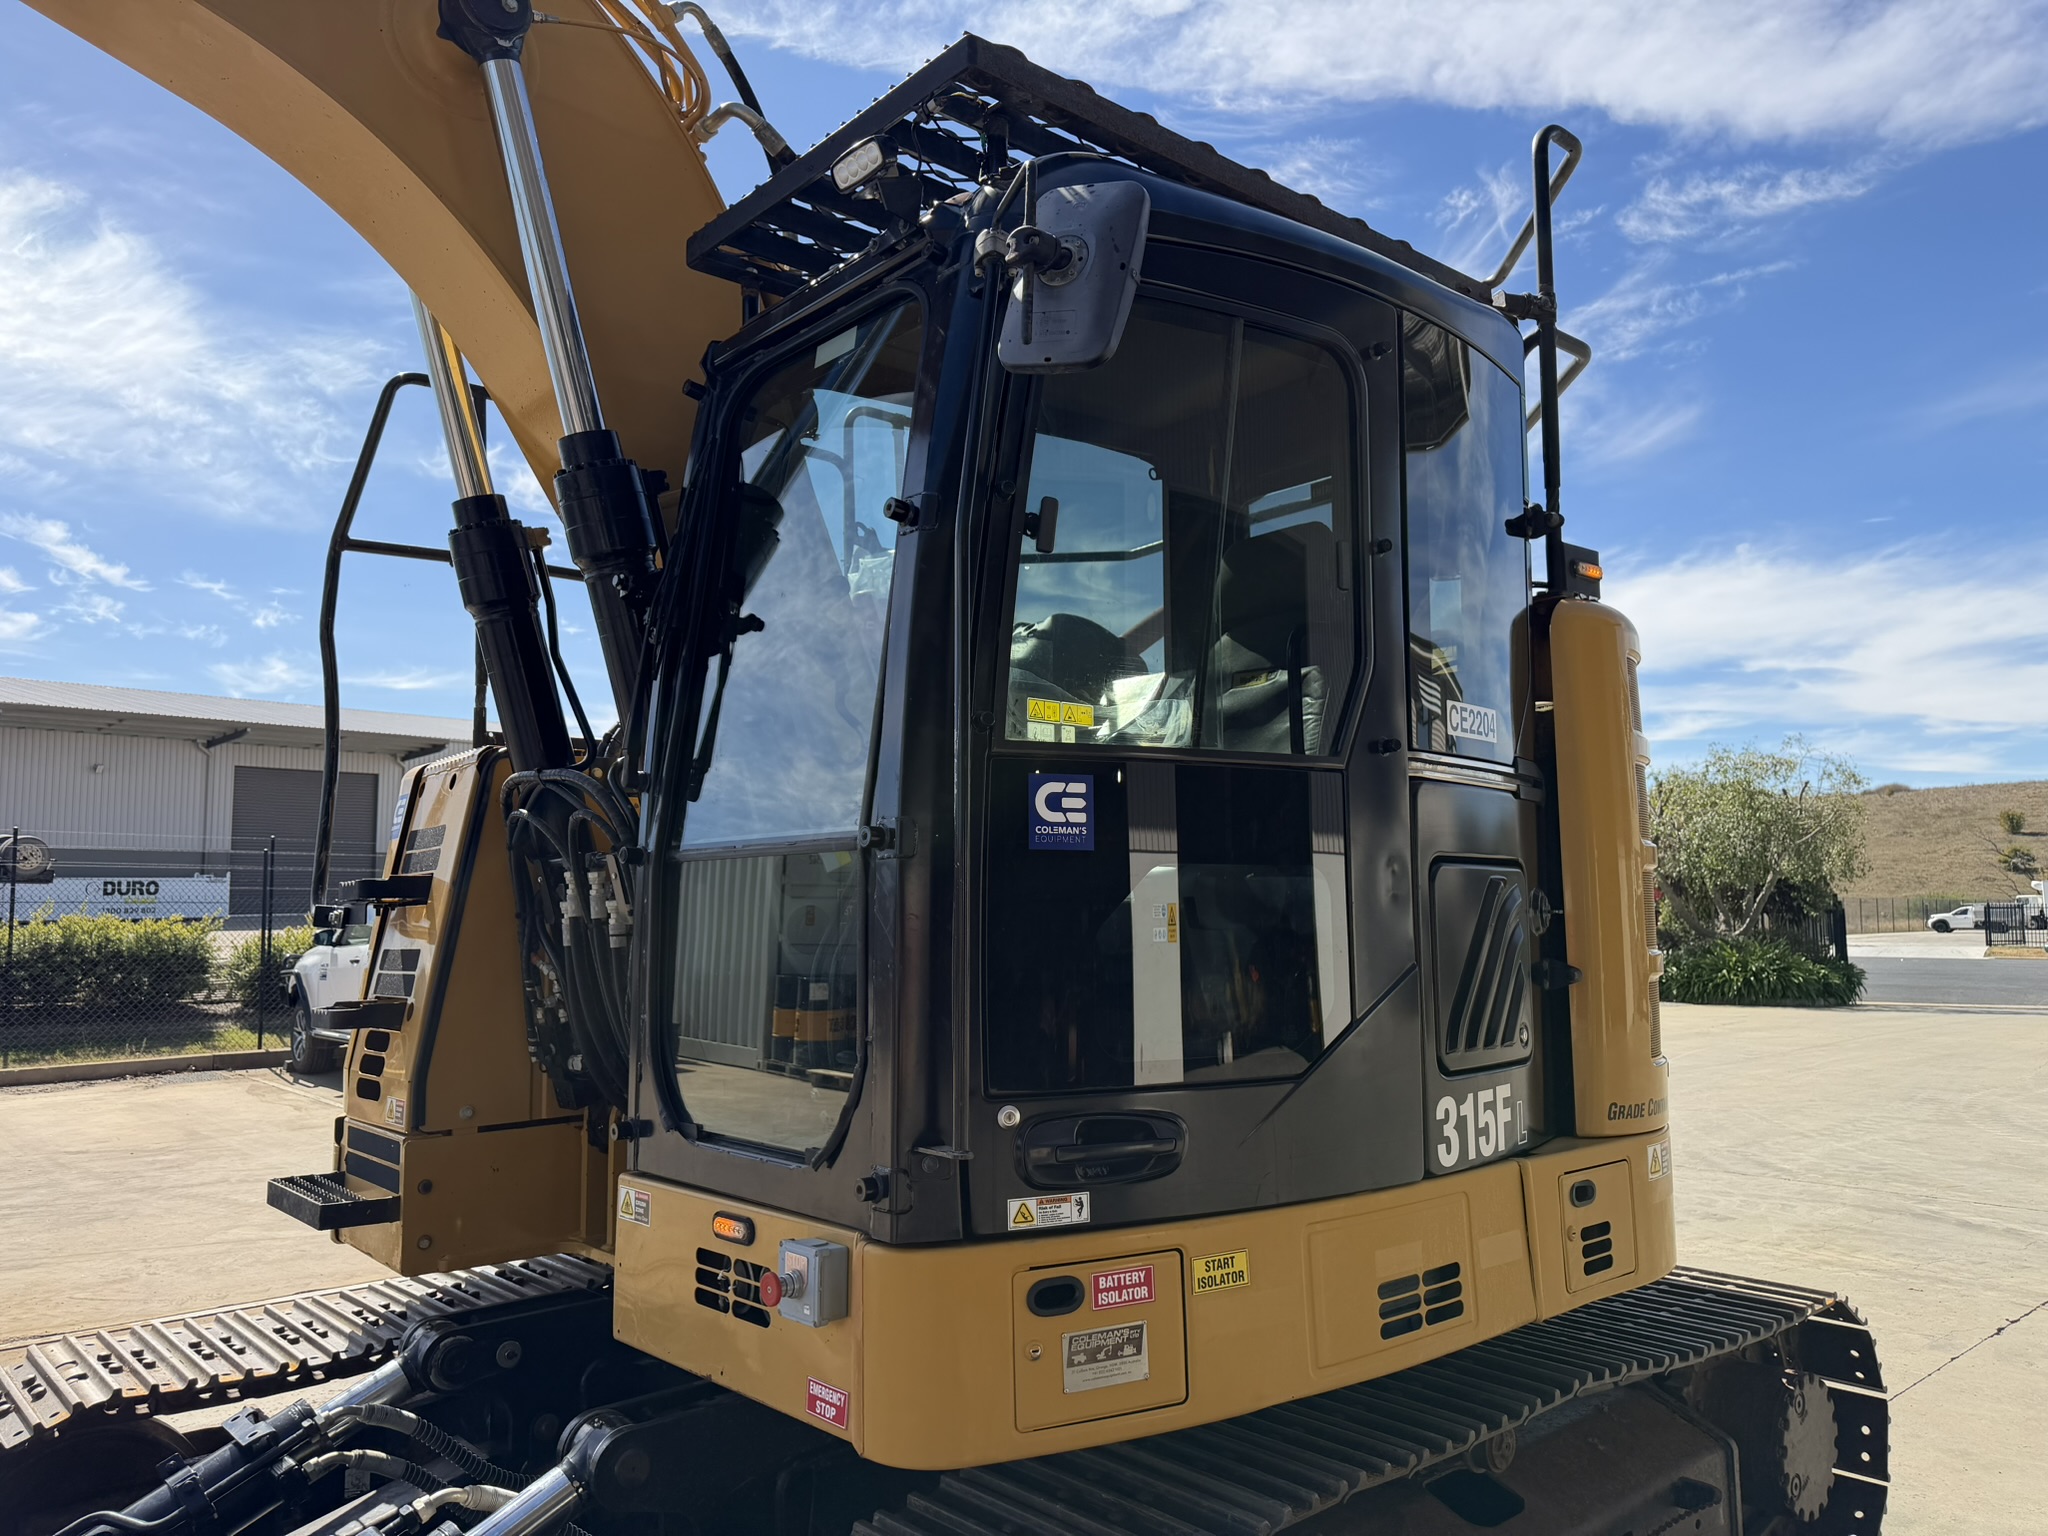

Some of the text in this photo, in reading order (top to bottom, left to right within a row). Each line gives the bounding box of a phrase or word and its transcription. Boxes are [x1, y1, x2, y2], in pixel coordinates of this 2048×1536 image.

[1449, 704, 1496, 739] CE2204
[1034, 781, 1087, 824] CE
[1035, 825, 1087, 835] COLEMAN'S
[1035, 835, 1087, 844] EQUIPMENT
[102, 880, 160, 896] DURO
[1607, 1101, 1646, 1121] GRADE
[1435, 1083, 1512, 1169] 315F
[1204, 1256, 1236, 1273] START
[1098, 1270, 1147, 1290] BATTERY
[1197, 1270, 1245, 1290] ISOLATOR
[1098, 1286, 1149, 1306] ISOLATOR
[1070, 1335, 1129, 1352] EQUIPMENT
[1071, 1328, 1130, 1345] COLEMAN'S
[809, 1380, 846, 1408] EMERGENCY
[815, 1400, 837, 1420] STOP
